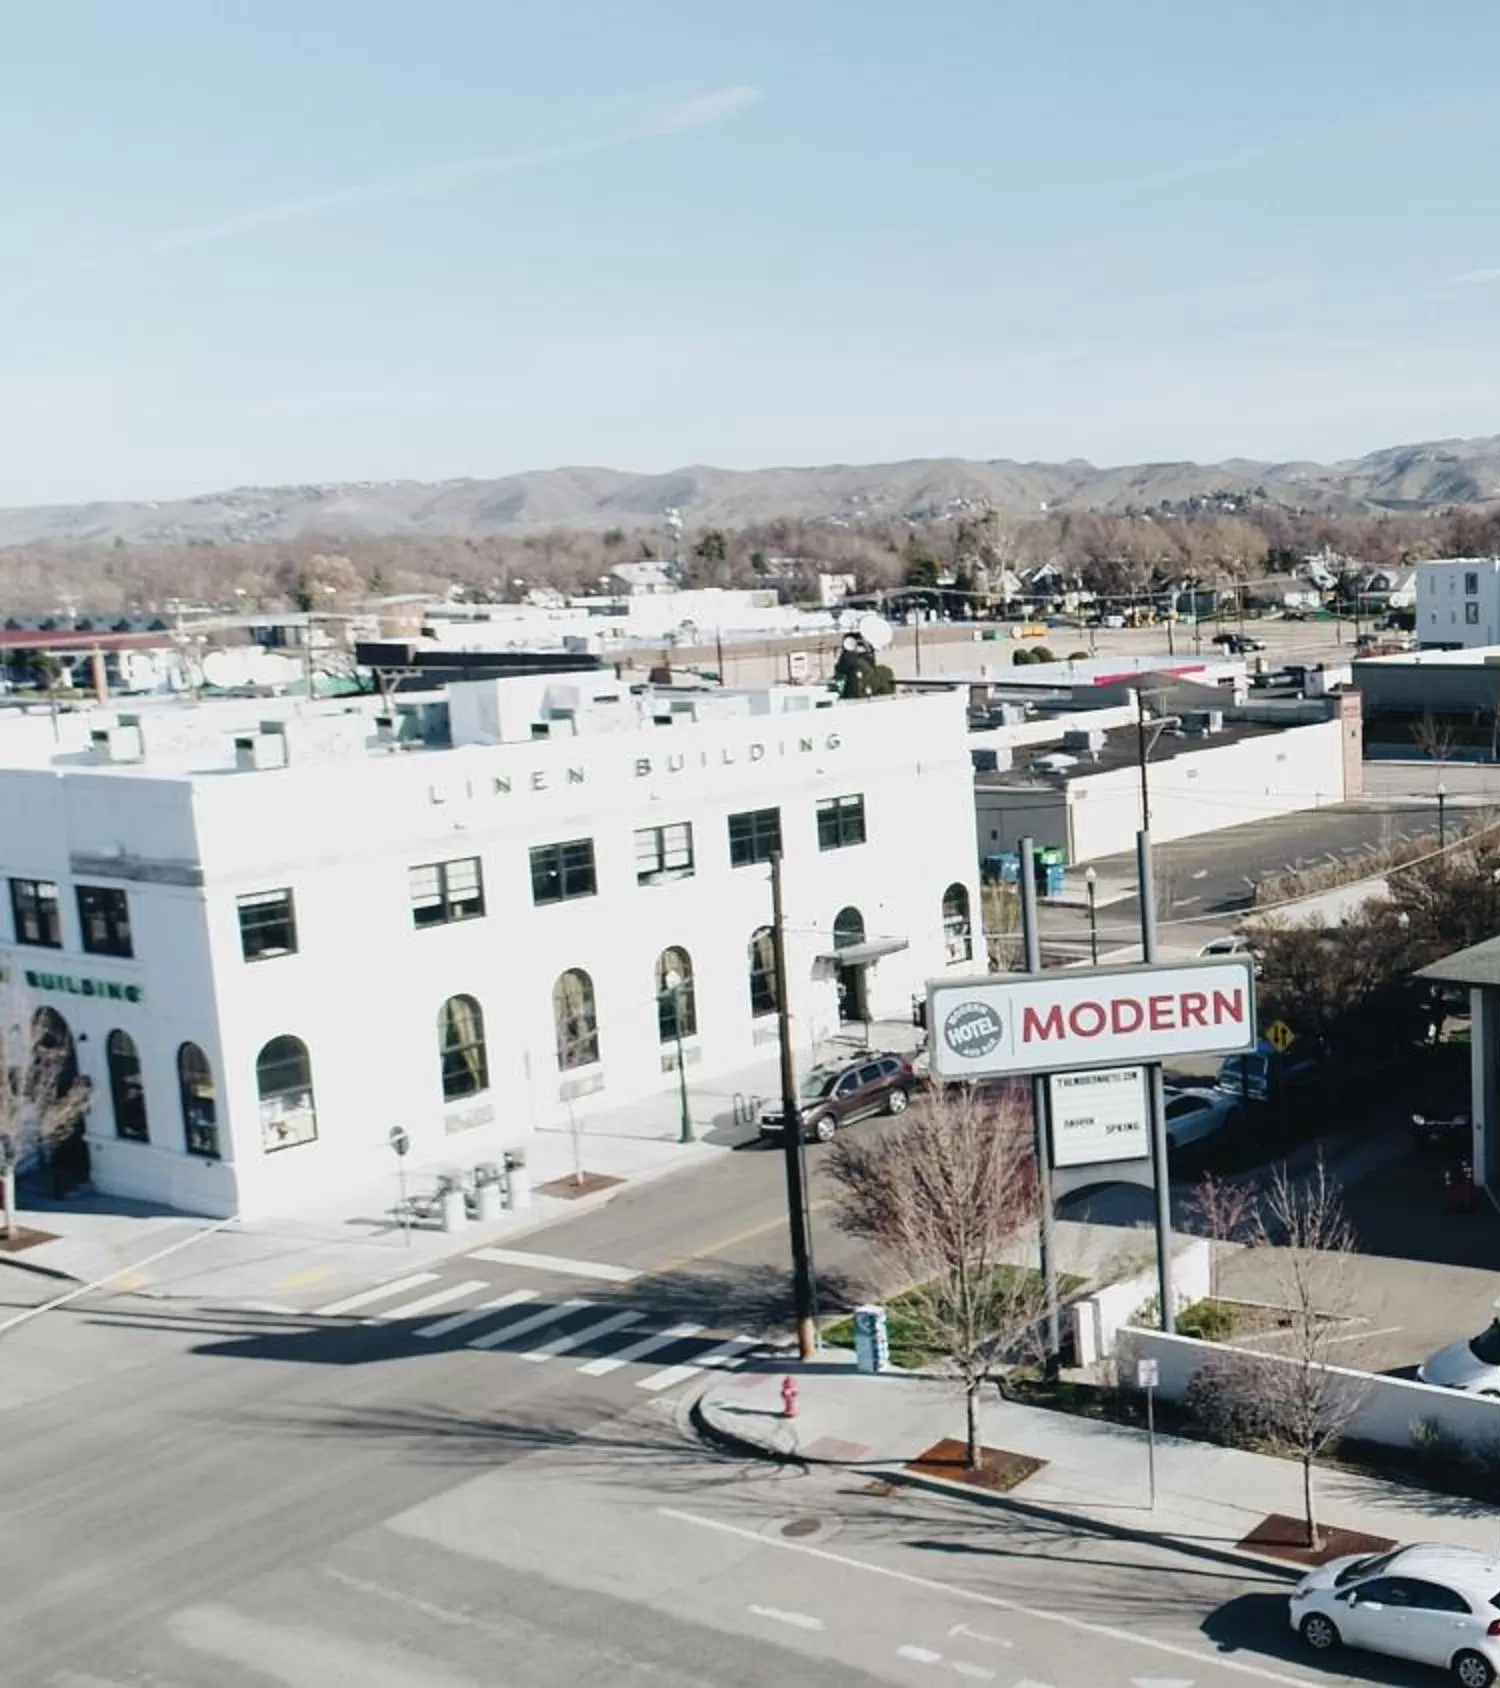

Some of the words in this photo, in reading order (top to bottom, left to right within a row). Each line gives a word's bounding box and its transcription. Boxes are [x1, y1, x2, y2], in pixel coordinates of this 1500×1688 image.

[428, 766, 586, 804] LINEN
[634, 732, 842, 777] BUILDING
[25, 970, 142, 1003] BUILDING
[948, 1016, 998, 1046] HOTEL
[1021, 988, 1244, 1043] MODERN
